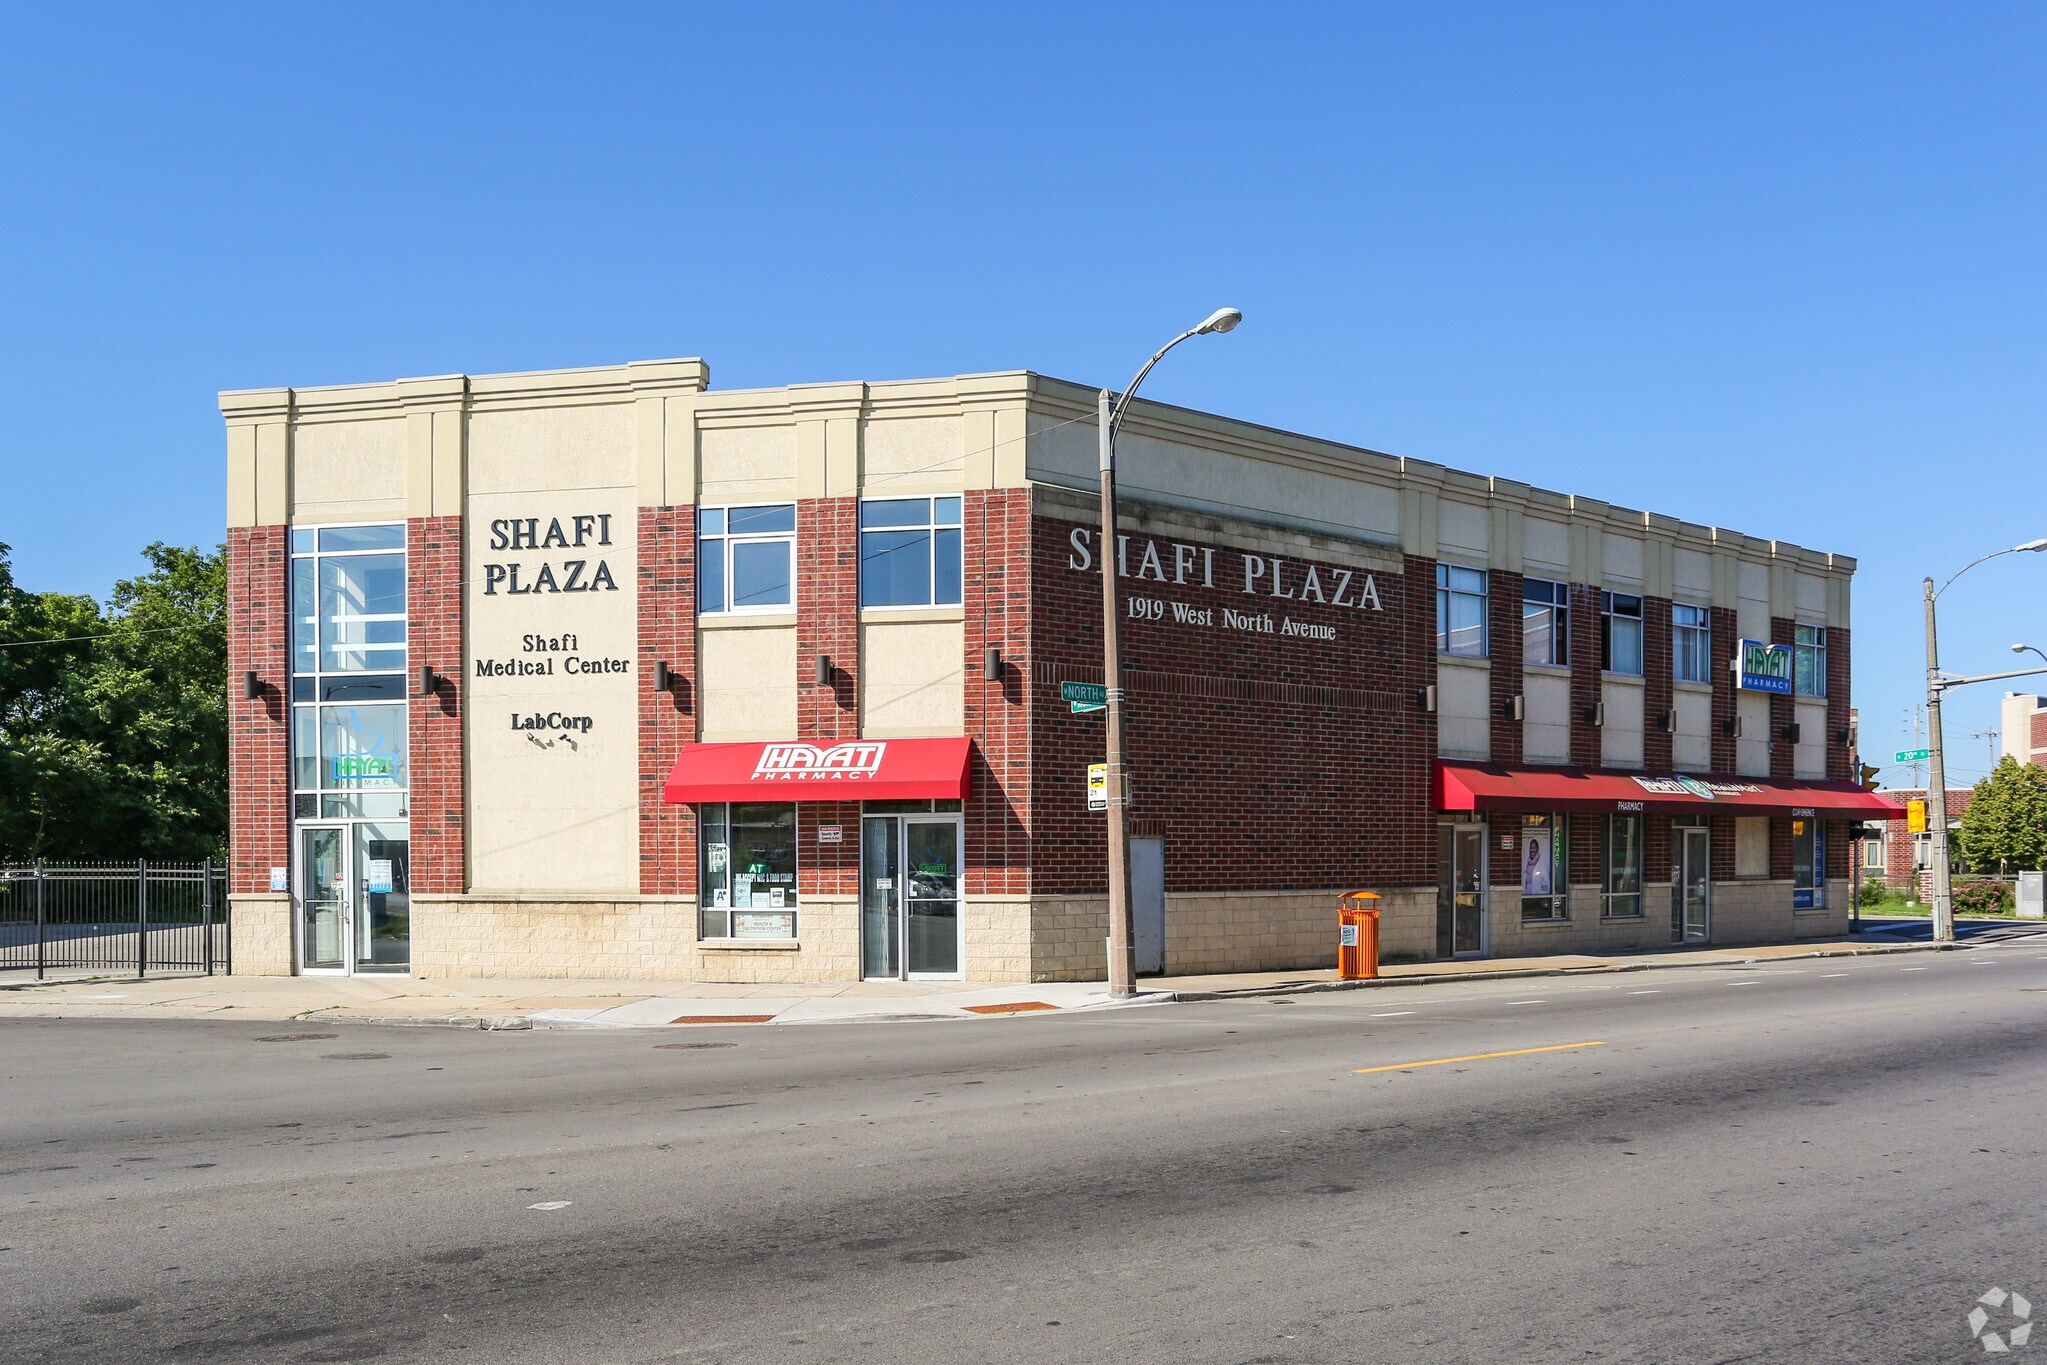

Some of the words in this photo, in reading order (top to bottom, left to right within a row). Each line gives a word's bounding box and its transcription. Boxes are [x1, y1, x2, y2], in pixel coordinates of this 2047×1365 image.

[490, 514, 612, 551] SHAFI
[484, 559, 618, 595] PLAZA
[1242, 554, 1384, 611] PLAZA
[1127, 597, 1164, 621] 1919
[1170, 602, 1213, 627] West
[1223, 608, 1274, 634] North
[1280, 616, 1337, 640] Avenue
[523, 633, 578, 652] Shafi
[476, 658, 554, 676] Medical
[564, 657, 630, 674] Center
[1745, 646, 1789, 677] HAYAT
[1068, 685, 1099, 700] NORTH
[1743, 677, 1789, 689] PHARMACY
[511, 712, 593, 733] LabCorp
[335, 757, 393, 776] HAYAT
[762, 745, 880, 769] HAYAT
[751, 771, 877, 781] PHARMACY
[1617, 801, 1644, 811] PHARMACY
[716, 891, 724, 901] A
